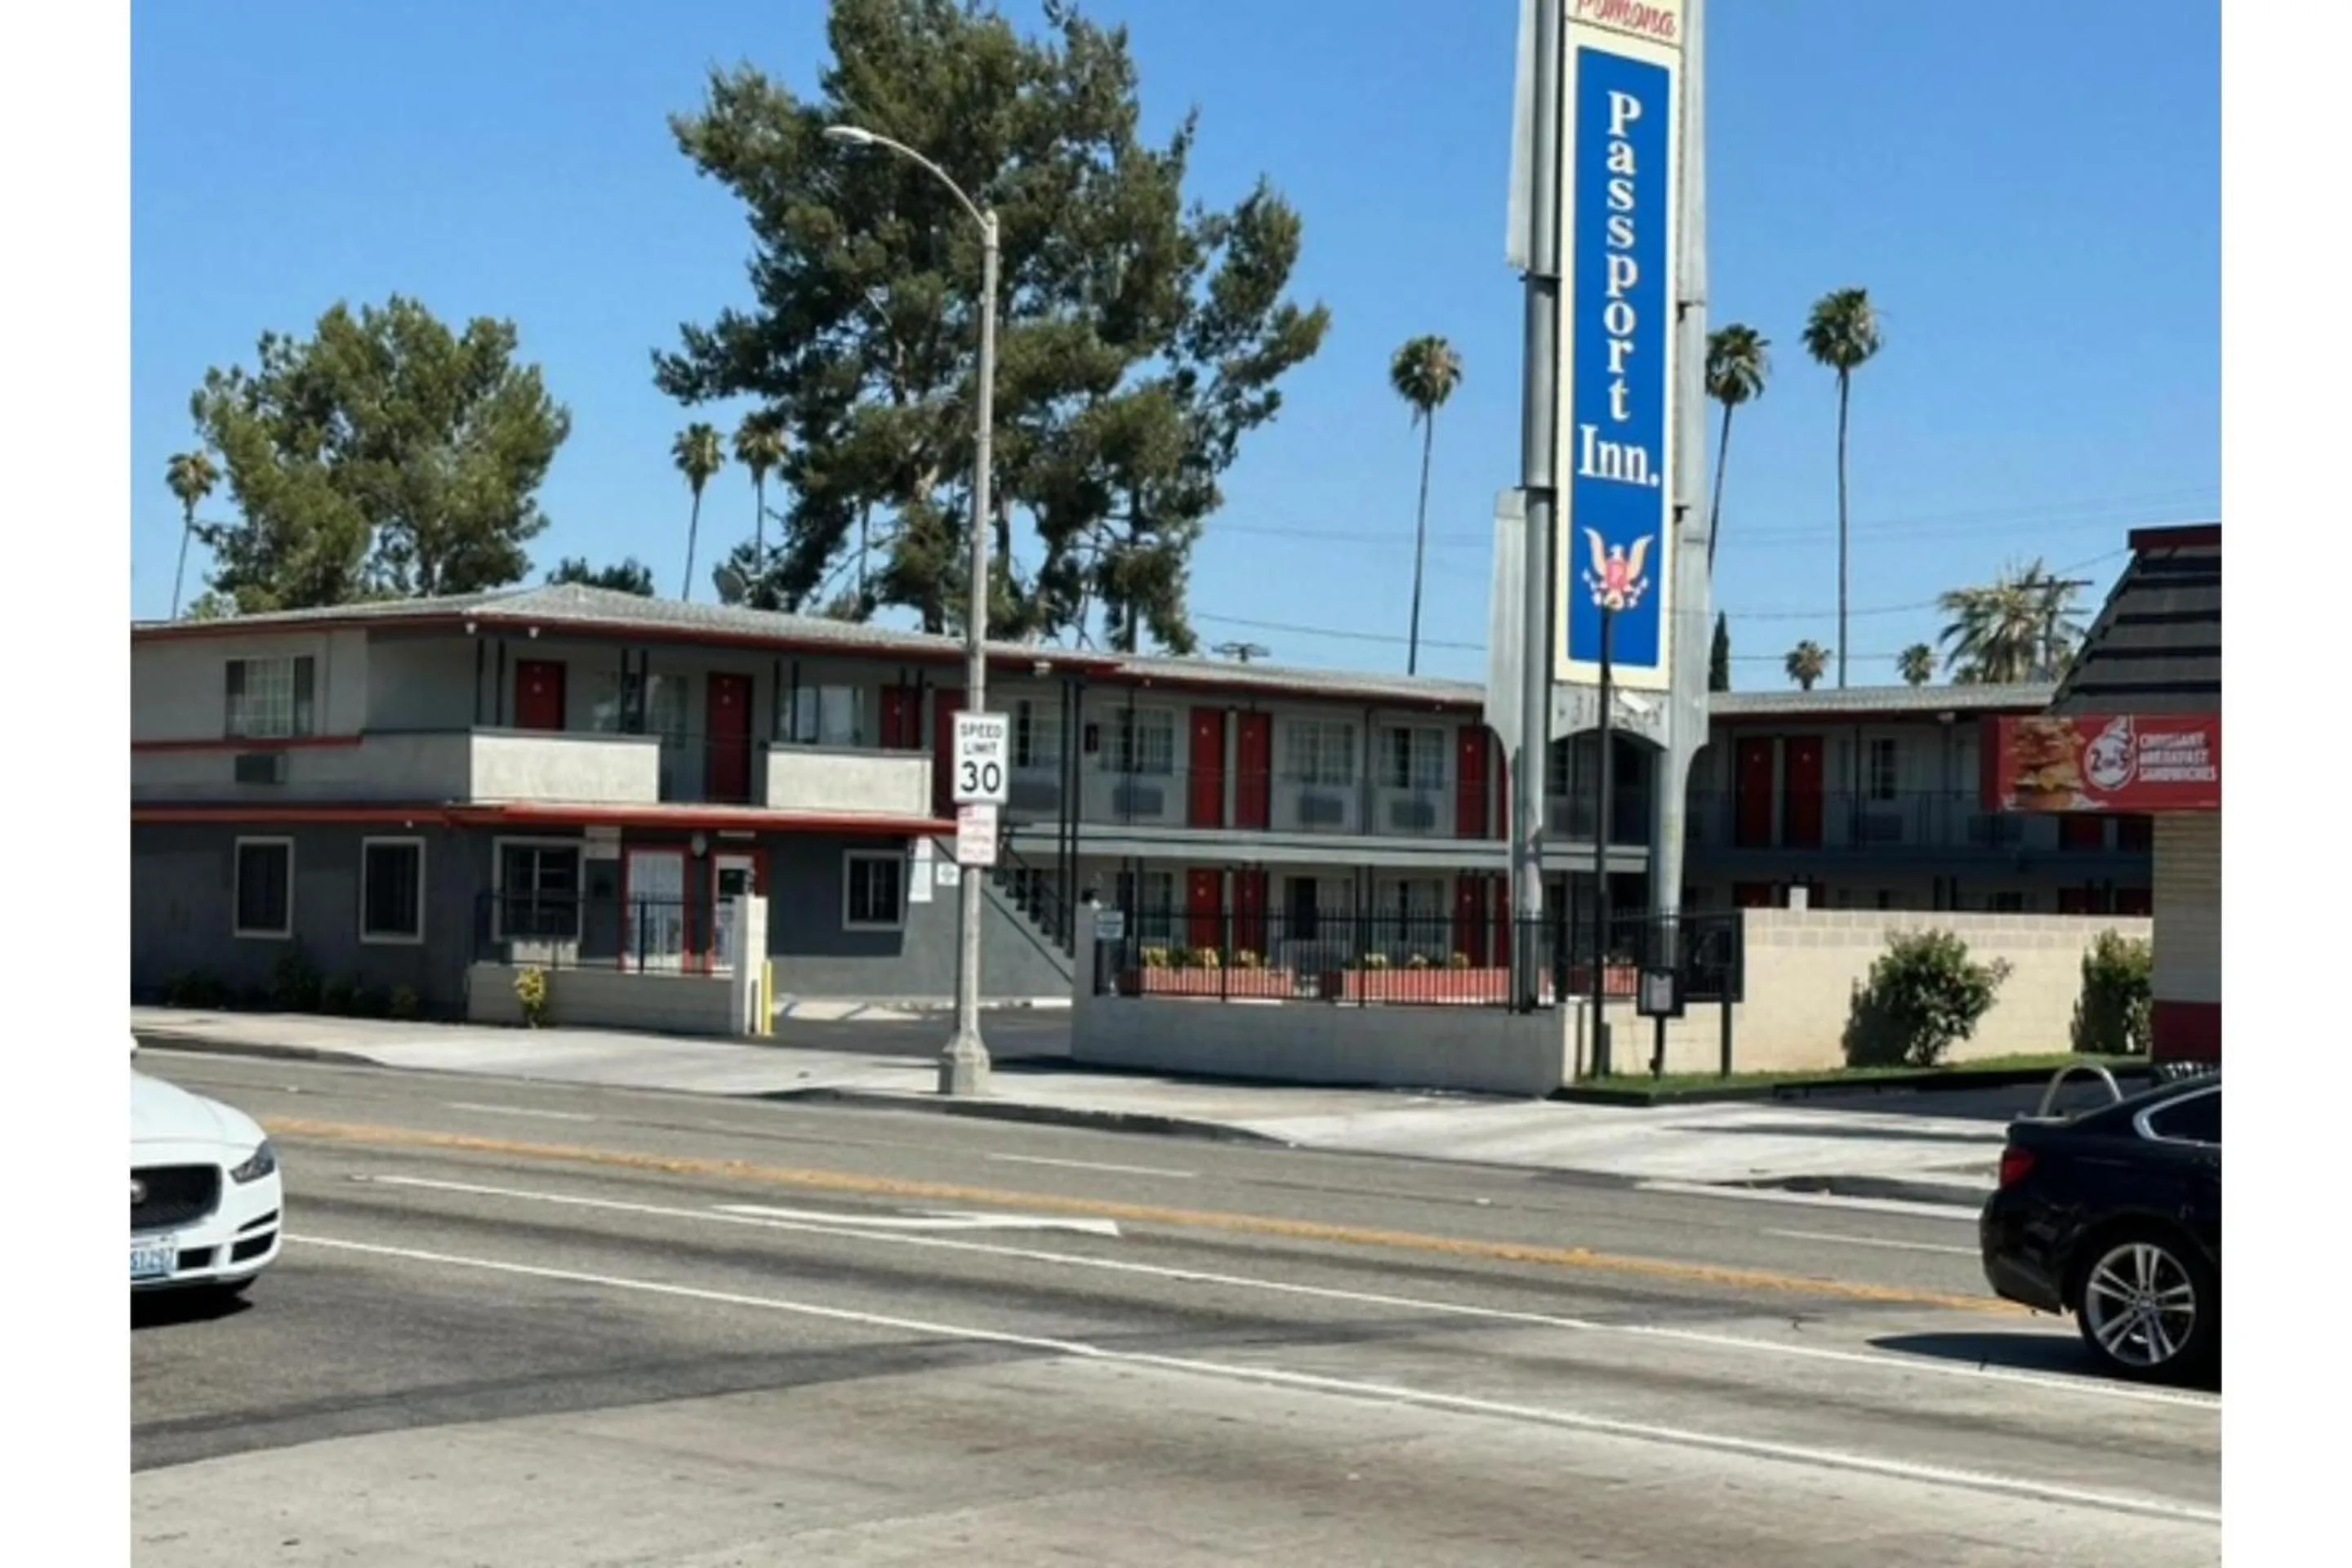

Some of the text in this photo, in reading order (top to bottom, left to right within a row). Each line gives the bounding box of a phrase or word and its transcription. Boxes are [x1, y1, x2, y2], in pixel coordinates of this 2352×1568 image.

[1603, 90, 1642, 421] Passport
[1579, 424, 1660, 488] Inn.
[960, 722, 1002, 738] SPEED
[963, 742, 997, 755] LIMIT
[2139, 750, 2210, 766] BREAKFAST
[960, 760, 1000, 794] 30
[2139, 766, 2216, 782] SANDWICHES
